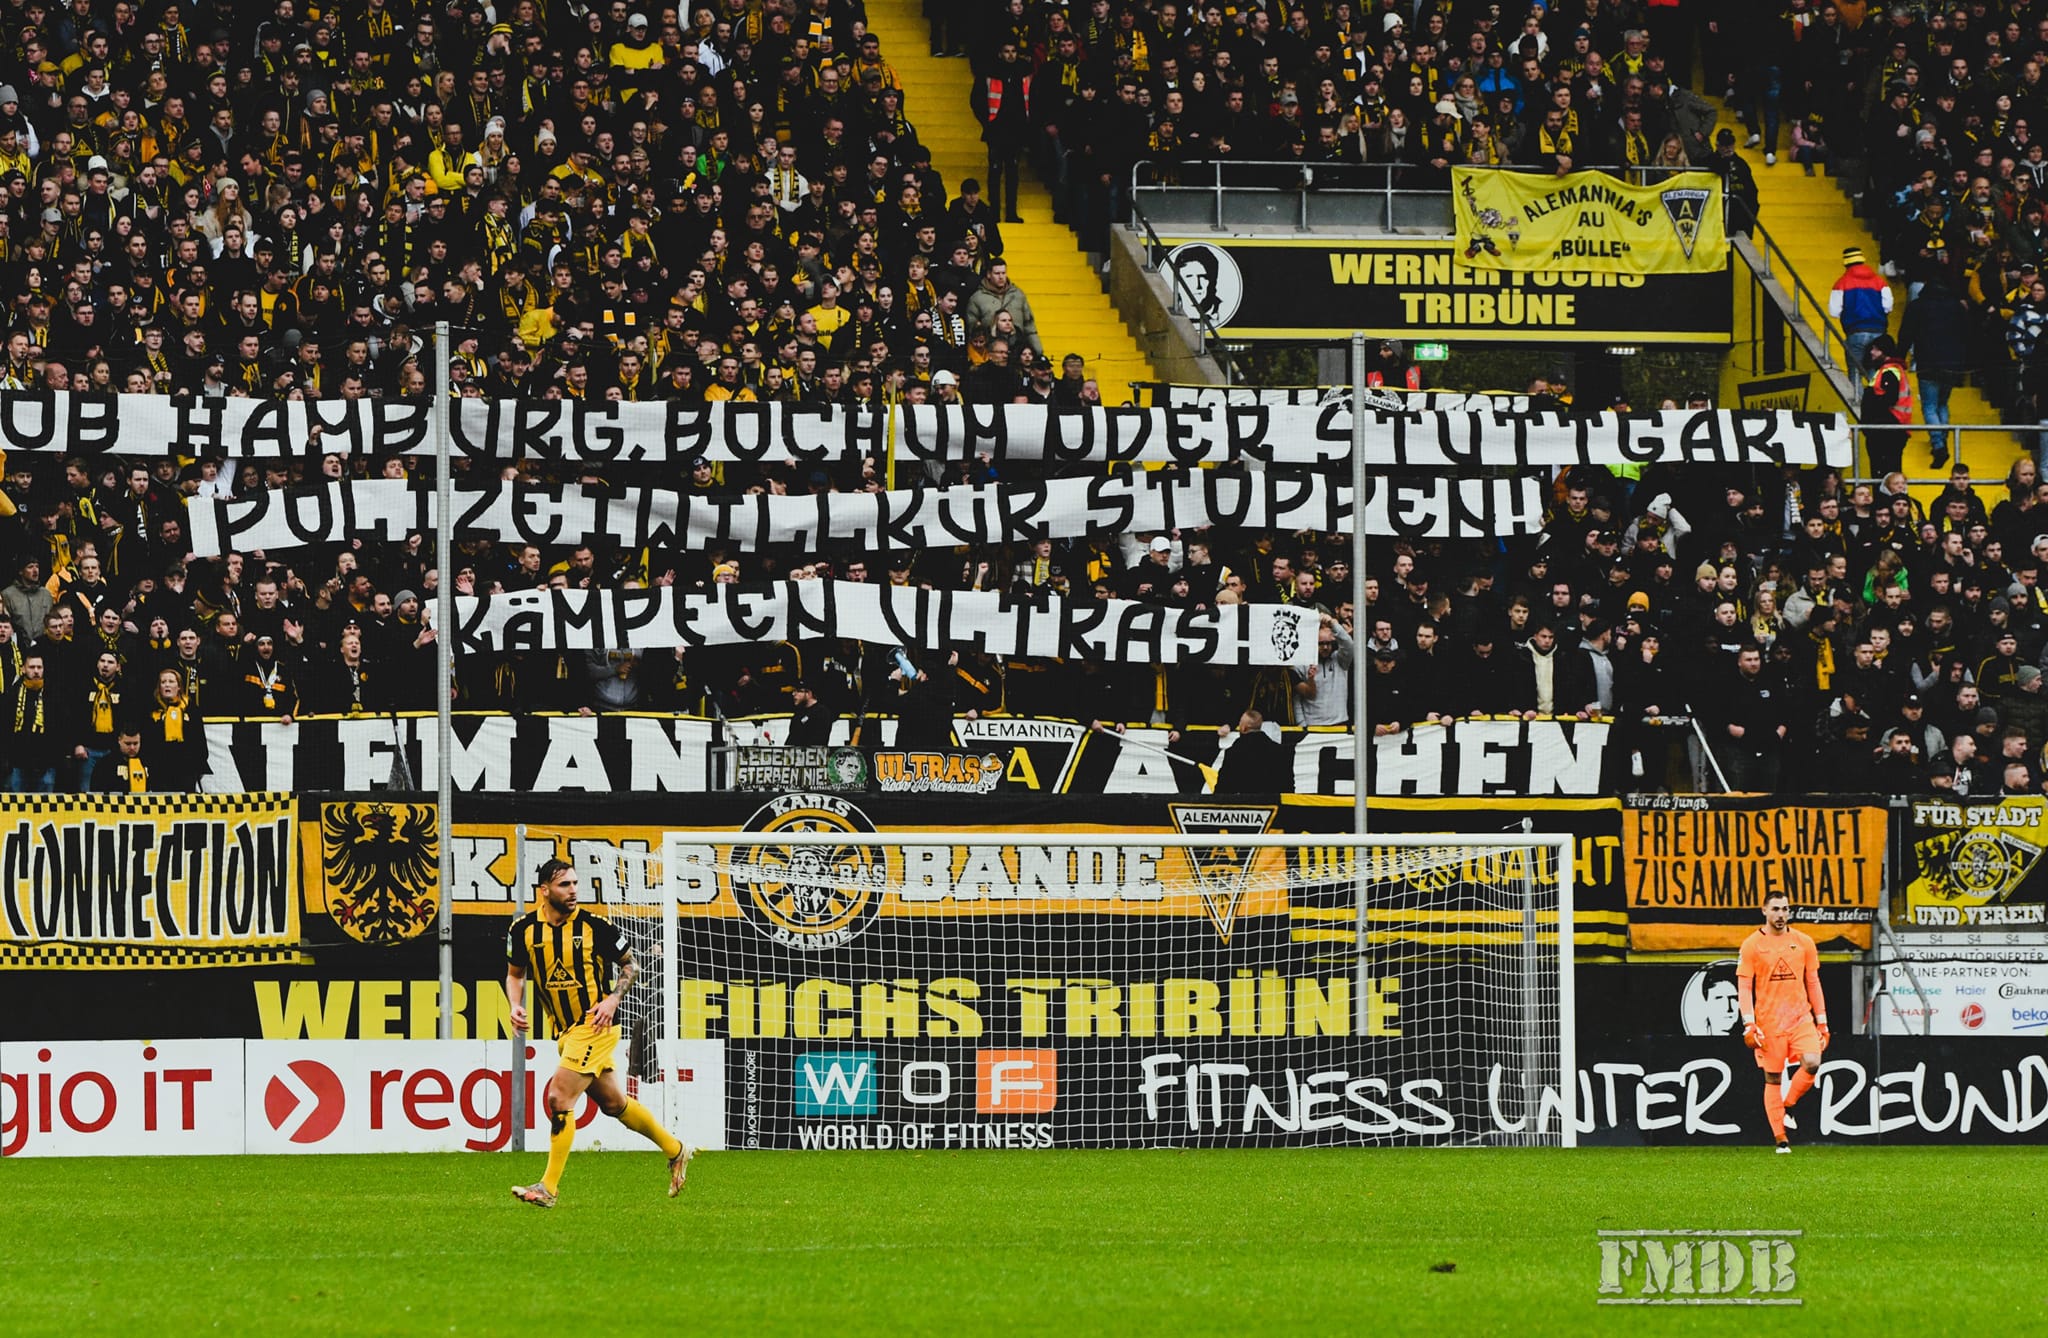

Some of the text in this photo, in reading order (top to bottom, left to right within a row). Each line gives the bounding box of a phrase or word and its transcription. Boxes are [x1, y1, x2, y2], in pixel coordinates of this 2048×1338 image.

[1523, 184, 1653, 227] ALEMANNIA'S
[1578, 211, 1604, 227] AU
[1400, 289, 1575, 325] TRIBÜNE
[664, 399, 1005, 461] BOCHUM
[1047, 402, 1273, 462] ODER
[1315, 407, 1840, 466] STUTTGART
[963, 724, 1076, 740] ALEMANNIA
[738, 767, 799, 785] STERBEN
[875, 752, 981, 784] ULTRAS
[770, 793, 850, 817] KARLS
[1182, 812, 1265, 824] ALEMANNIA
[1913, 801, 2042, 827] FÜR STADT
[1637, 808, 1862, 857] FREUNDSCHAFT
[3, 817, 291, 939] CONNECTION
[900, 842, 1166, 903] BANDE
[1633, 858, 1867, 907] ZUSAMMENHALT
[1915, 904, 2046, 925] UND VEREIN
[772, 926, 856, 949] BANDE
[680, 976, 983, 1039] FUCHS
[1006, 967, 1402, 1038] TRIBÜNE
[2003, 985, 2048, 997] Baukne
[1138, 1053, 1456, 1134] FITNESS
[797, 1122, 1052, 1150] WORLD OF FITNESS
